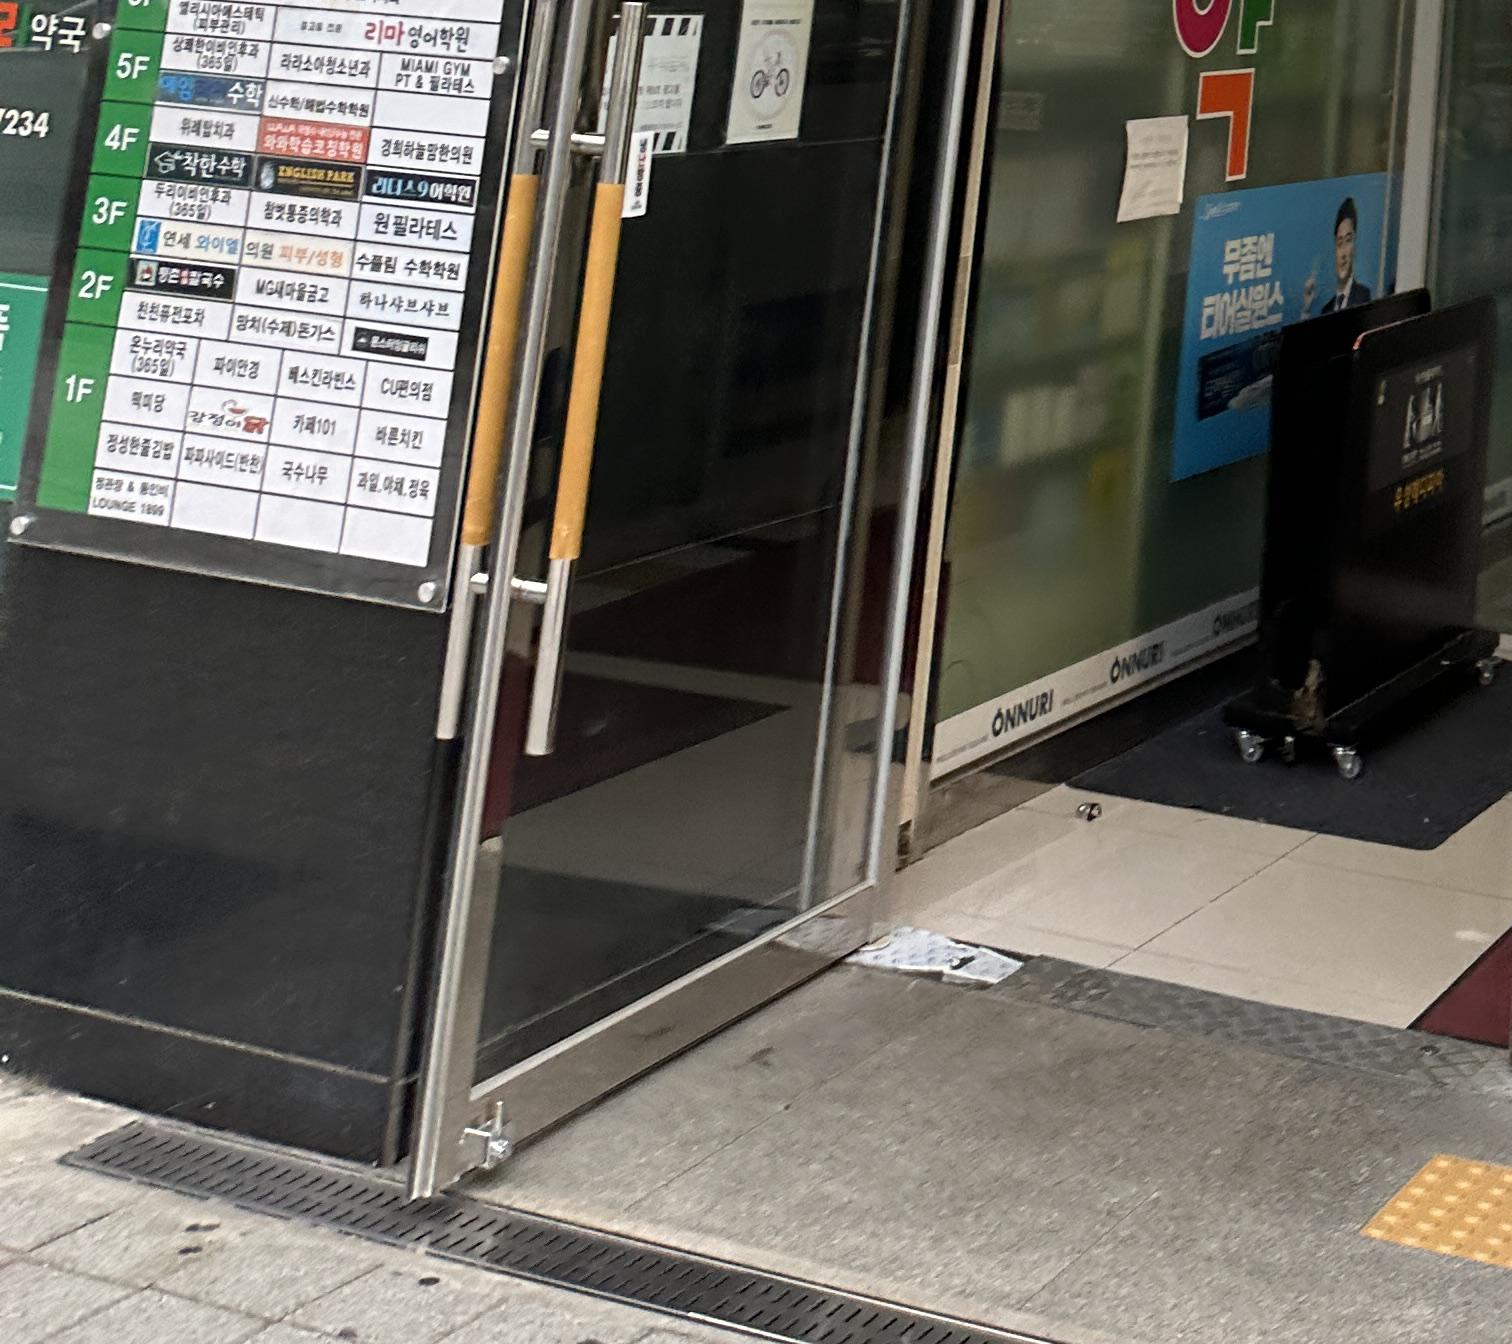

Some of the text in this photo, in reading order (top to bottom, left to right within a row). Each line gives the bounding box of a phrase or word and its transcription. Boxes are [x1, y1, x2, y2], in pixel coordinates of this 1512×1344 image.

[31, 14, 86, 54] 약국
[364, 20, 470, 53] 리마 영어학원
[116, 53, 150, 79] 5F
[280, 53, 371, 78] 라라소아청소년과
[400, 58, 471, 76] MIAMI GYM
[227, 81, 263, 108] 수학
[395, 74, 475, 94] PT & 필라테스
[104, 124, 139, 152] 4F
[182, 151, 246, 178] 착한수학
[277, 165, 355, 183] ENGLISH PARK
[92, 197, 127, 225] 3F
[163, 230, 190, 249] 연세
[246, 242, 274, 260] 의원
[279, 244, 343, 266] 피부/성형
[404, 258, 461, 280] 수학학원
[78, 271, 113, 298] 2F
[256, 279, 329, 303] MG새마을금고
[360, 292, 449, 317] 하나샤브샤브
[130, 336, 187, 359] 온누리약국
[65, 375, 94, 402] 1F
[289, 366, 356, 390] 배스킨라빈스
[381, 378, 433, 401] CU편의점
[293, 414, 336, 436] 카페101
[376, 426, 423, 449] 바른치킨
[282, 461, 328, 482] 국수나무
[991, 689, 1054, 738] ONNURI
